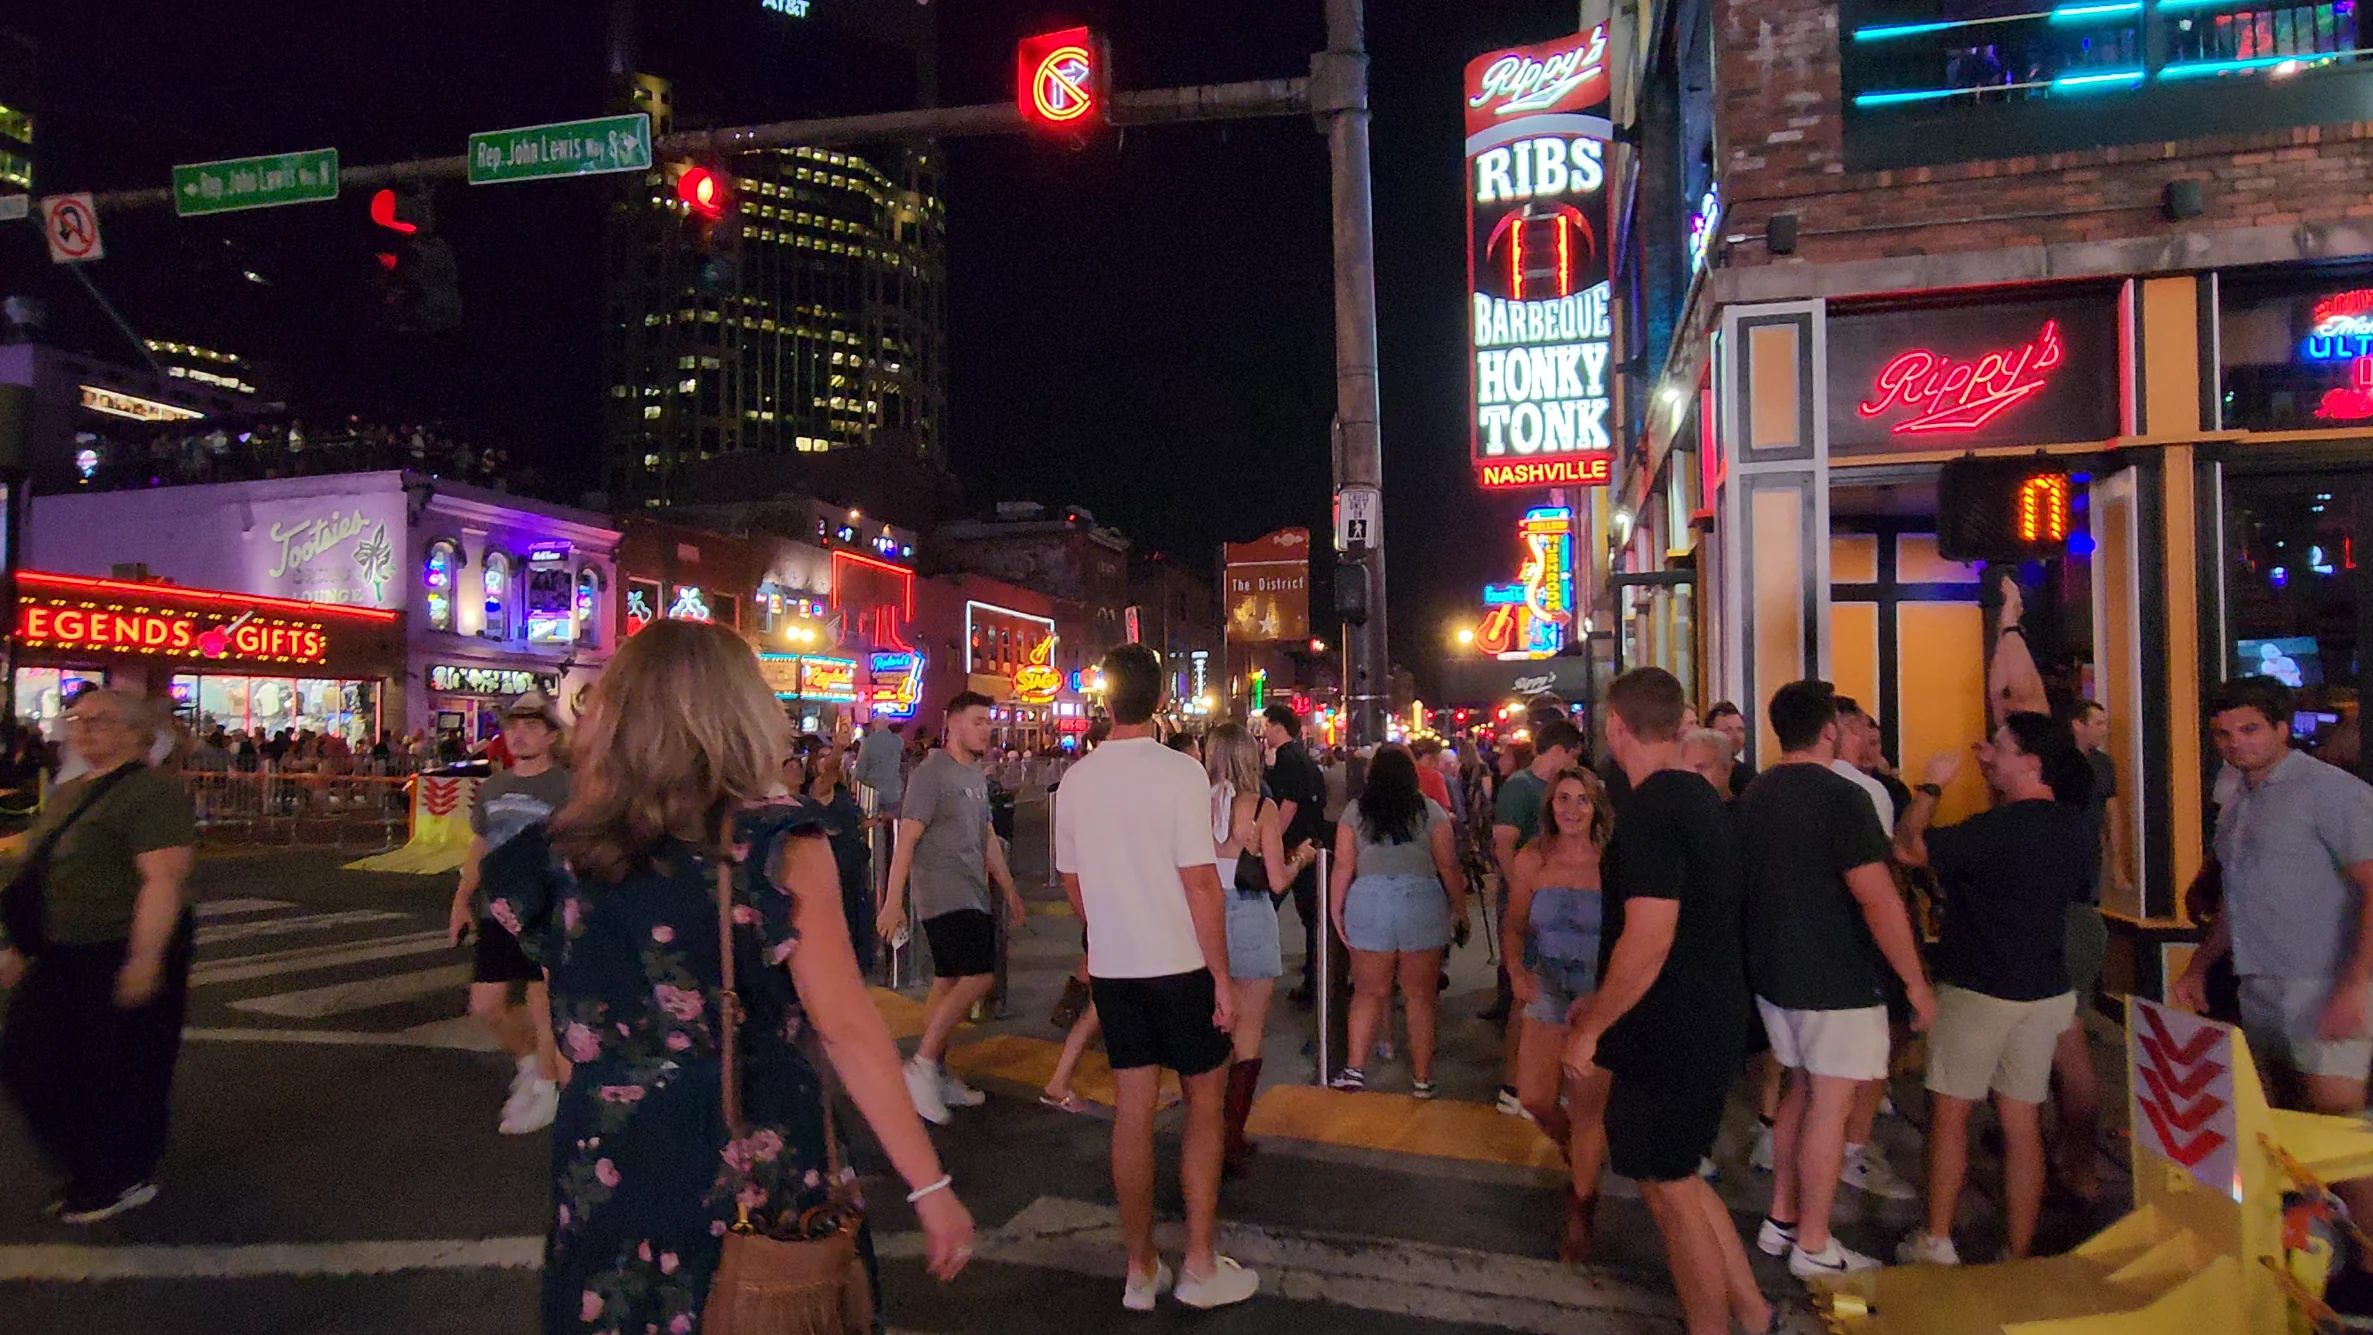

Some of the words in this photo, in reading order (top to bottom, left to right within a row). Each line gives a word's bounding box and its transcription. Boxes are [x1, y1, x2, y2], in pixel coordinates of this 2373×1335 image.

[1469, 25, 1607, 109] Rippy's
[507, 138, 538, 166] John
[541, 131, 582, 162] Lewis
[1476, 137, 1604, 203] RIBS
[1474, 280, 1612, 347] BARBEQUE
[1477, 342, 1609, 404] HONKY
[1861, 320, 2060, 416] Rippy's
[1479, 398, 1611, 456] TONK
[1484, 460, 1607, 485] NASHVILLE
[268, 509, 370, 578] Tootsies
[1232, 578, 1251, 592] The
[1258, 576, 1304, 592] District
[15, 608, 191, 647] EGENDS
[236, 625, 318, 657] GIFTS
